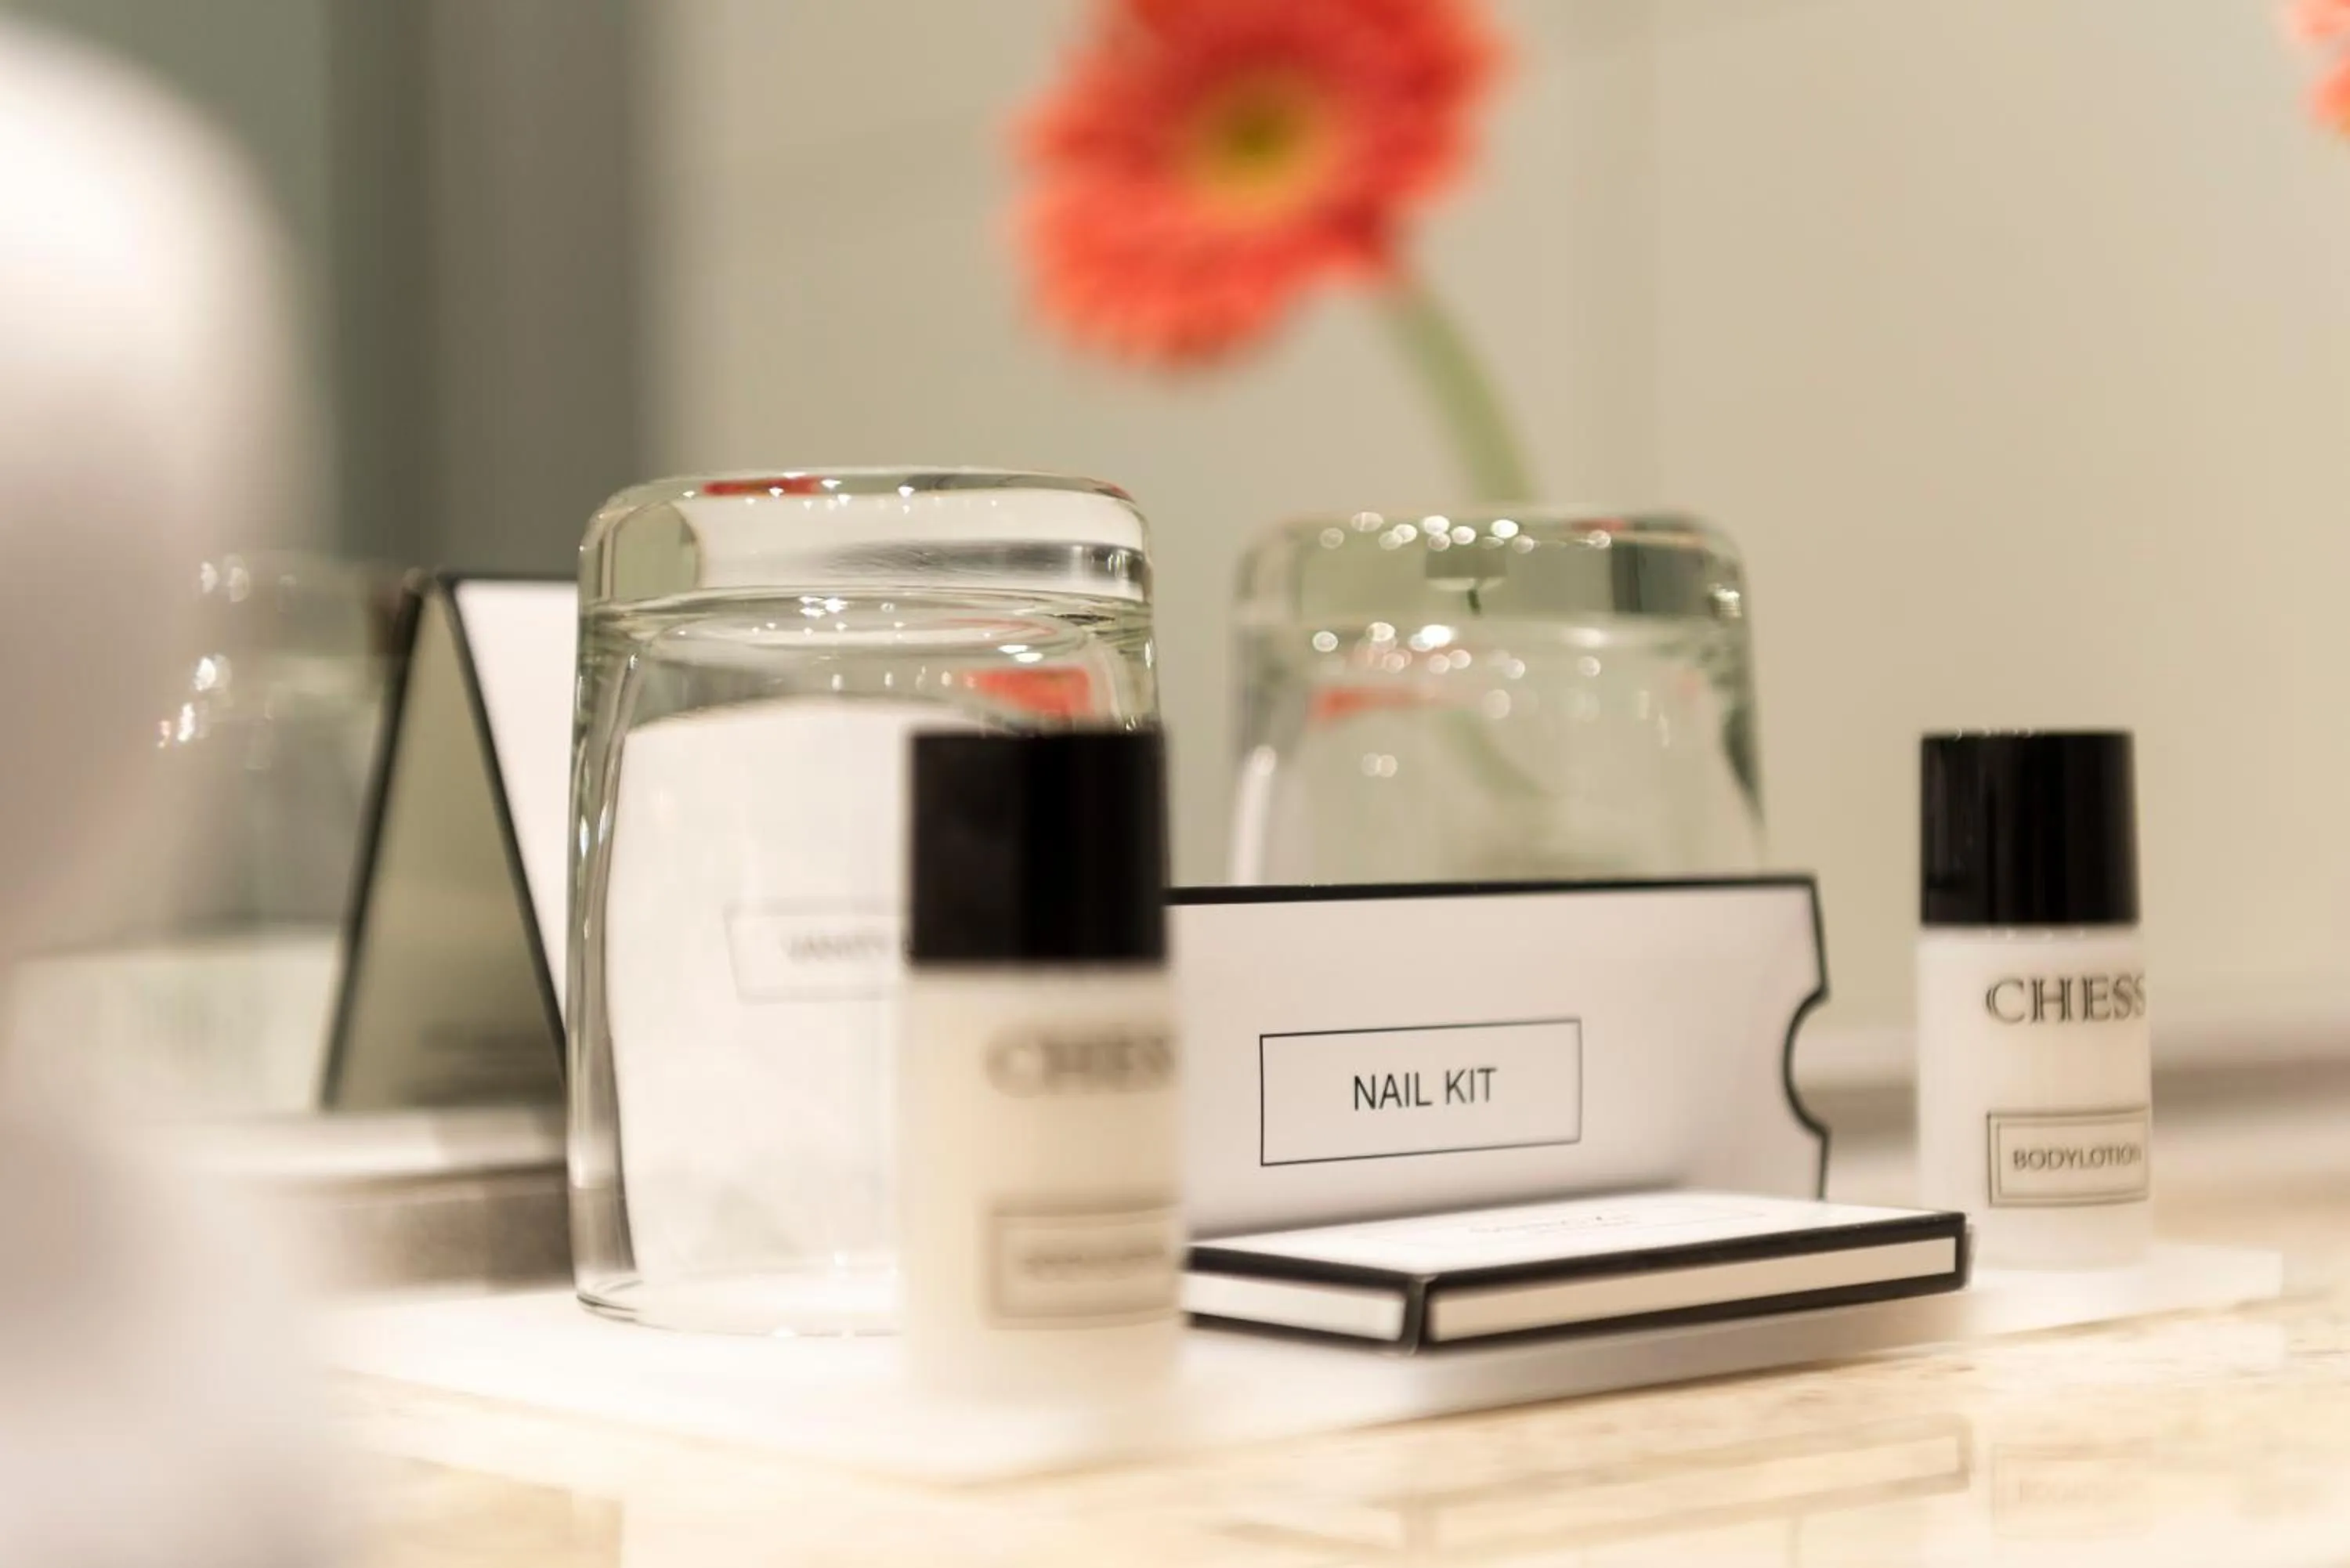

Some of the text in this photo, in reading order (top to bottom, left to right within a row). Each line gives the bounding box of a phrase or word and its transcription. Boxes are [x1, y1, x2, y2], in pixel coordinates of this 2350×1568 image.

[1984, 974, 2146, 1024] CHESS
[1353, 1067, 1497, 1111] NAIL KIT
